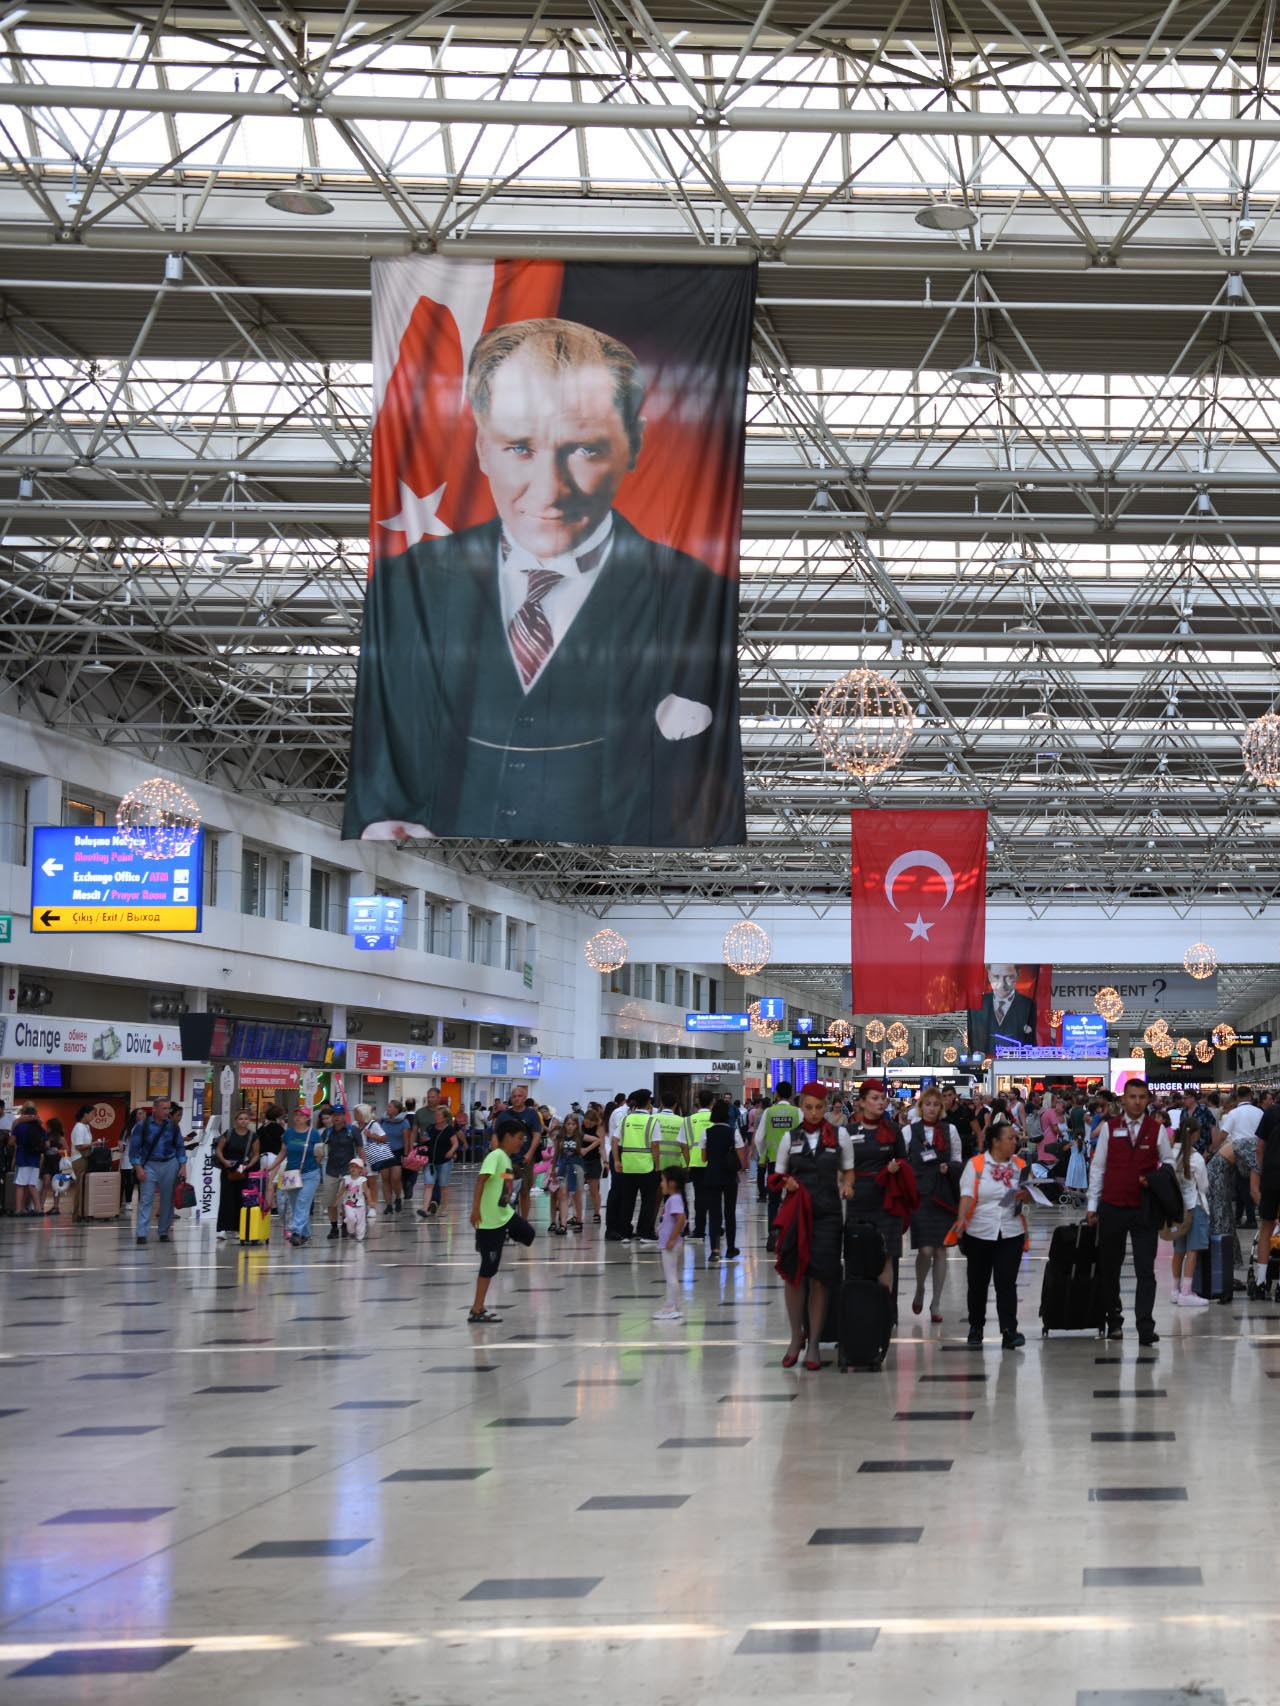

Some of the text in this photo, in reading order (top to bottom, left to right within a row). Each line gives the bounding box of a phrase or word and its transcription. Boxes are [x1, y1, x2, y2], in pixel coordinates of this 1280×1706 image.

[74, 852, 134, 864] Meeting Point
[73, 871, 113, 885] Exchange
[114, 871, 141, 883] Office
[149, 872, 169, 882] ATM
[72, 889, 101, 900] Mescit
[111, 889, 139, 902] Prayer
[142, 890, 167, 900] Room
[72, 912, 93, 925] Çıkış
[102, 912, 118, 922] Exit
[126, 913, 160, 923] Выход
[15, 1022, 61, 1054] Change
[68, 1029, 88, 1041] обмен
[63, 1042, 87, 1053] валюты
[126, 1032, 152, 1054] Döviz
[1148, 1082, 1182, 1091] BURGER
[199, 1153, 216, 1214] wispotter
